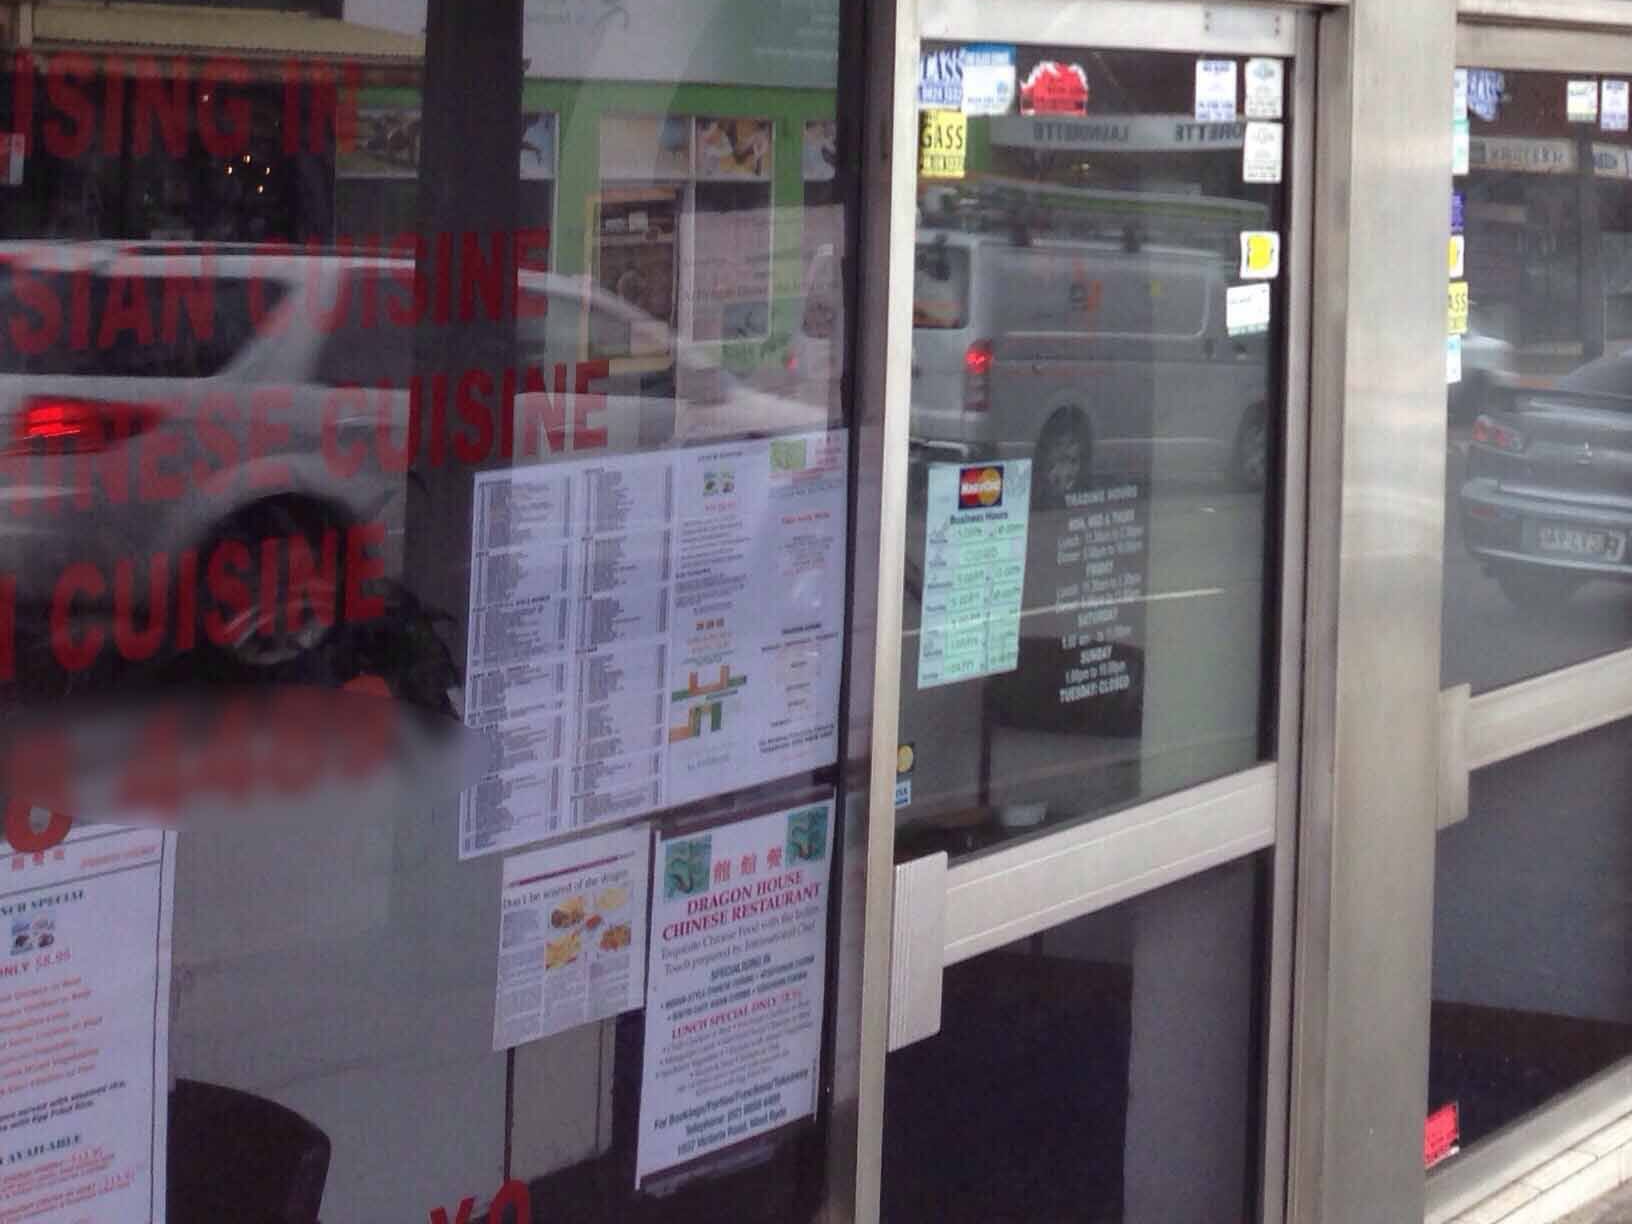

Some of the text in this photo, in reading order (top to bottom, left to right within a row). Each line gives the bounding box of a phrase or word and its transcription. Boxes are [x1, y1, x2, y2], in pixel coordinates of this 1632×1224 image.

[282, 55, 366, 157] IN
[246, 226, 552, 338] CUISINE
[319, 356, 611, 478] CUISINE
[49, 519, 386, 672] CUISINE
[661, 881, 822, 943] CHINESE RESTAURANT
[686, 870, 803, 916] DRAGON HOUSE
